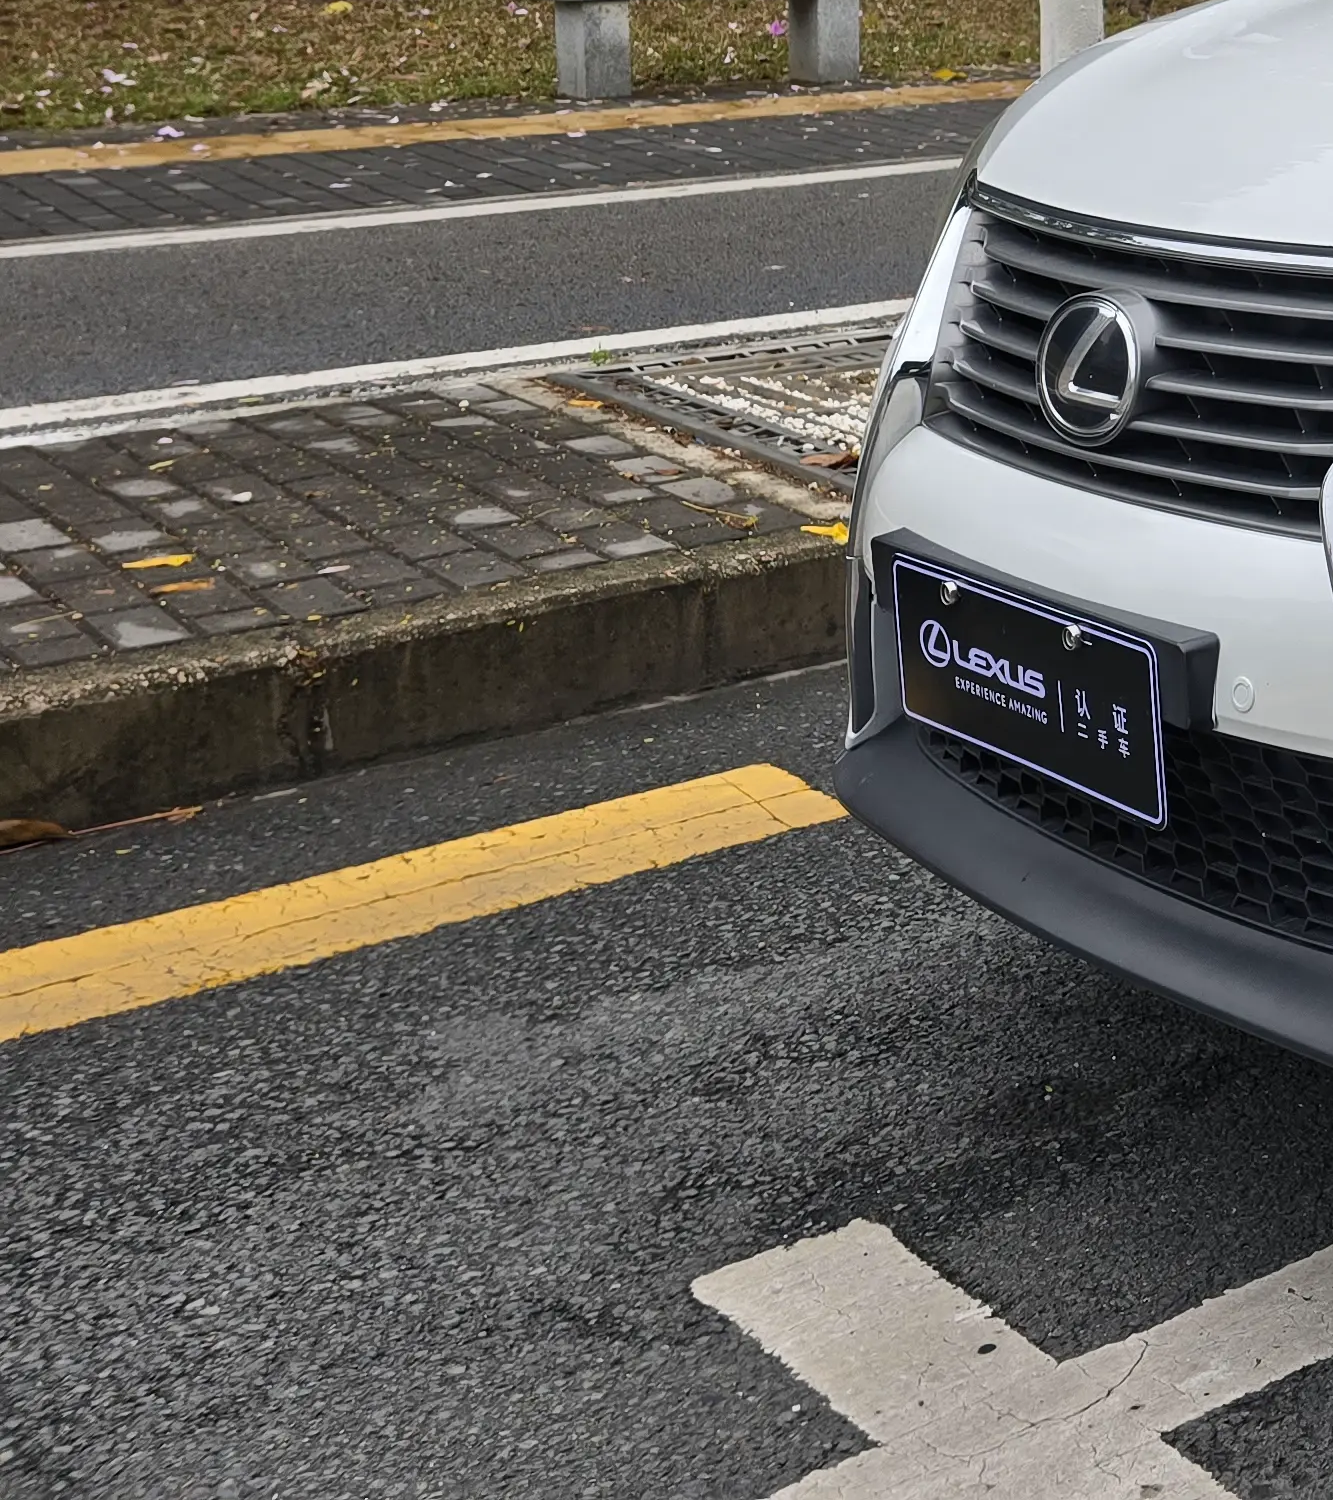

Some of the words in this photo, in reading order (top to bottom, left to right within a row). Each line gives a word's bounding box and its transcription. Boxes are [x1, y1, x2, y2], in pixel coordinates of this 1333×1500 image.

[953, 639, 1046, 699] LEXUS
[954, 675, 1008, 709] EXPERIENCE
[1008, 698, 1048, 725] AMAZING
[1074, 688, 1129, 735] 认证
[1077, 722, 1131, 759] 二手车
